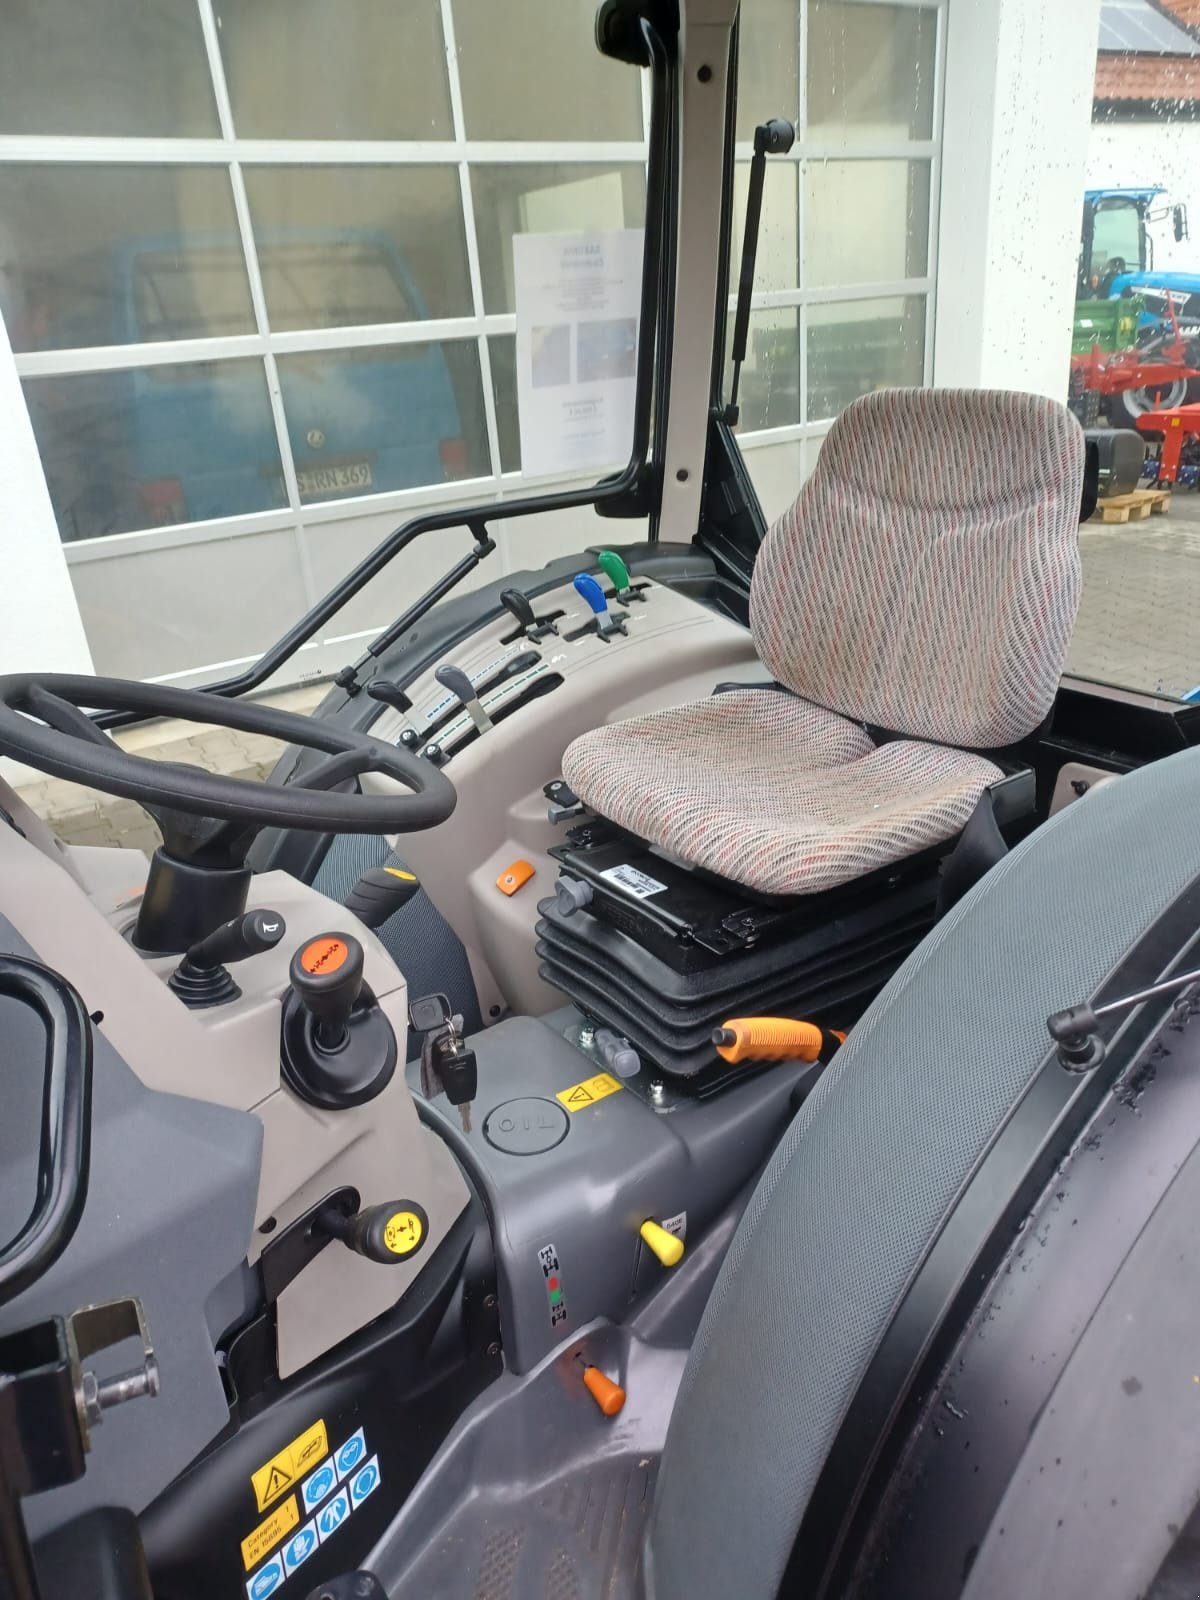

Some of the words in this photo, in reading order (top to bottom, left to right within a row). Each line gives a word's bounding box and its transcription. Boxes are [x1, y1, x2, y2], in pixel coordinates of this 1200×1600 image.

[315, 470, 338, 489] RN
[341, 464, 369, 487] 369
[499, 1114, 555, 1132] OIL
[248, 1517, 278, 1548] Category
[250, 1546, 260, 1560] EN
